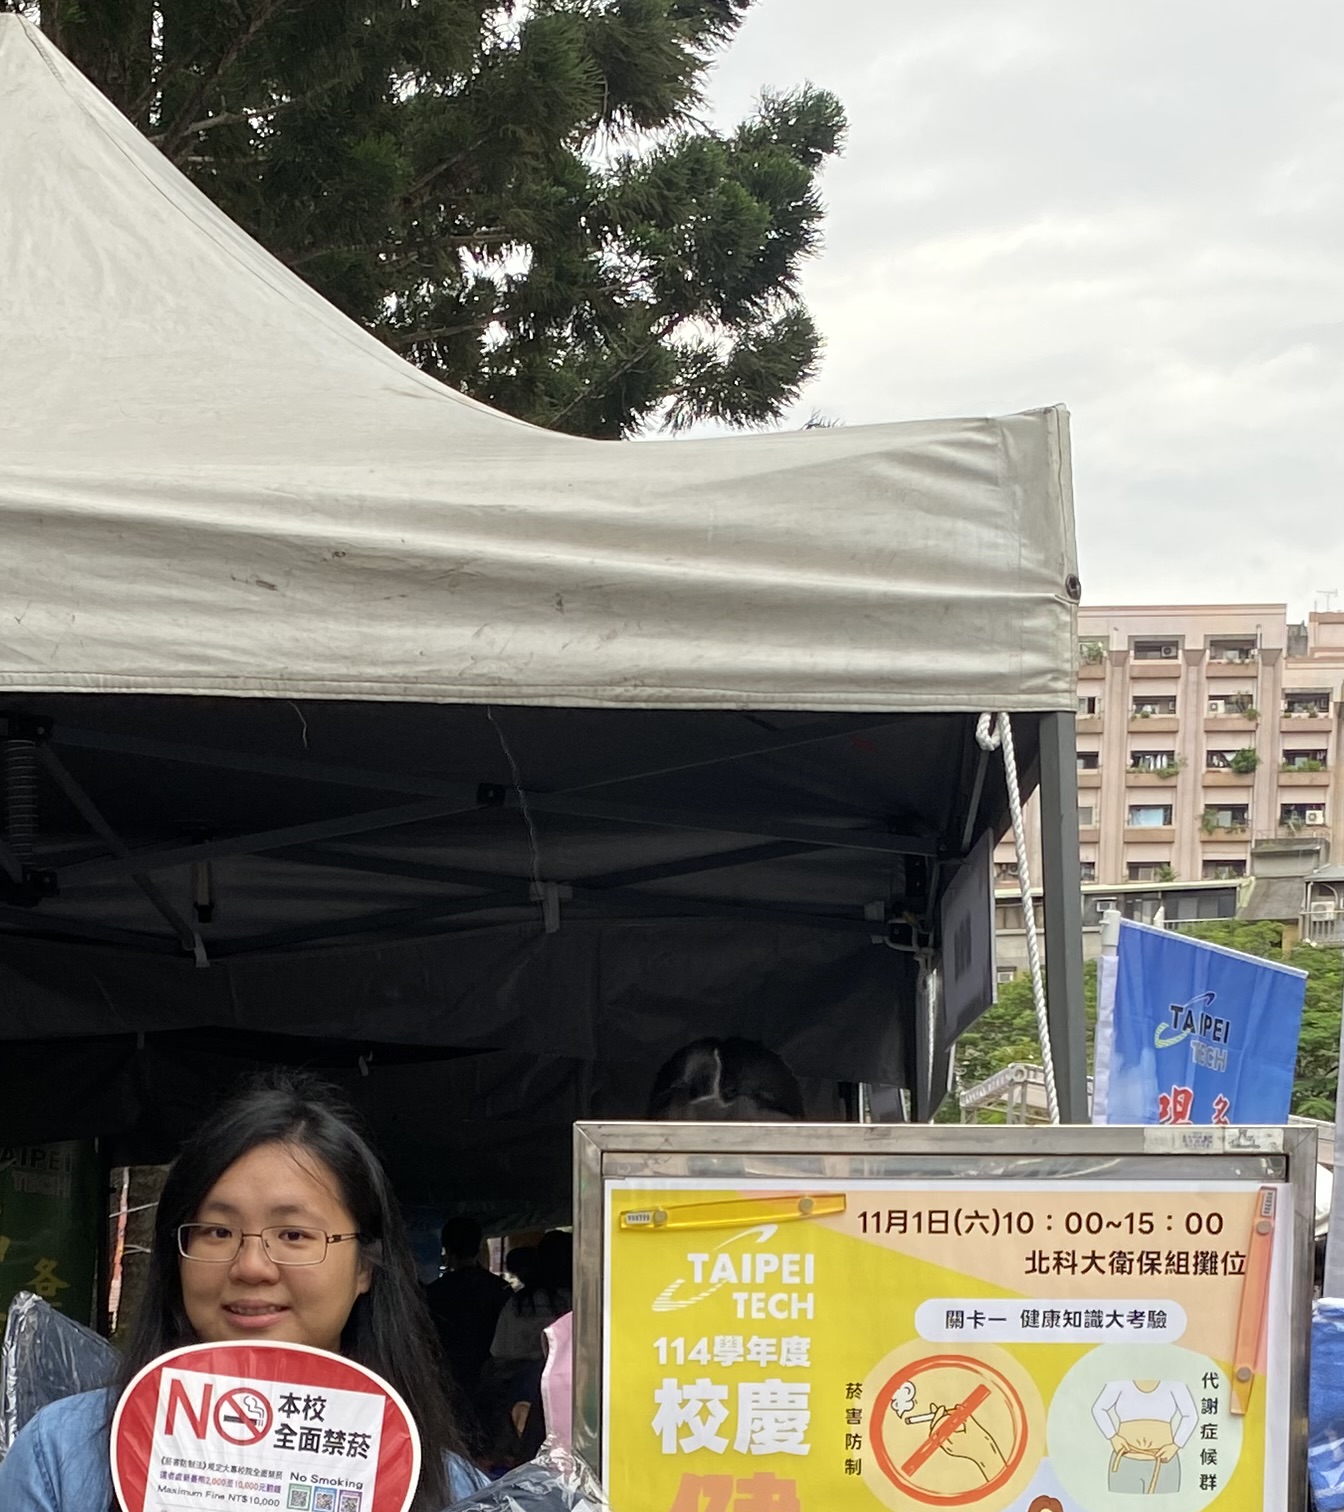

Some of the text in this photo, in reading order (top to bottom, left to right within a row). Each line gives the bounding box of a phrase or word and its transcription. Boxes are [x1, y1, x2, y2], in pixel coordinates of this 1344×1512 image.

[1169, 1004, 1231, 1044] TAIPEI
[1191, 1040, 1229, 1073] TECH
[687, 1253, 815, 1285] TAIPEI
[1025, 1251, 1247, 1277] 北科大衛保組攤位
[733, 1292, 815, 1320] TECH
[1020, 1308, 1168, 1331] 健康知識大考驗
[653, 1335, 812, 1367] 114學年度
[277, 1392, 327, 1423] 本校
[651, 1377, 812, 1457] 校慶
[273, 1423, 372, 1460] 全面禁菸
[845, 1381, 864, 1477] 菸害防制
[1199, 1370, 1219, 1492] 代謝症候群
[289, 1471, 364, 1491] No Smoking
[205, 1489, 225, 1501] Fine
[228, 1493, 281, 1508] NT$10,000
